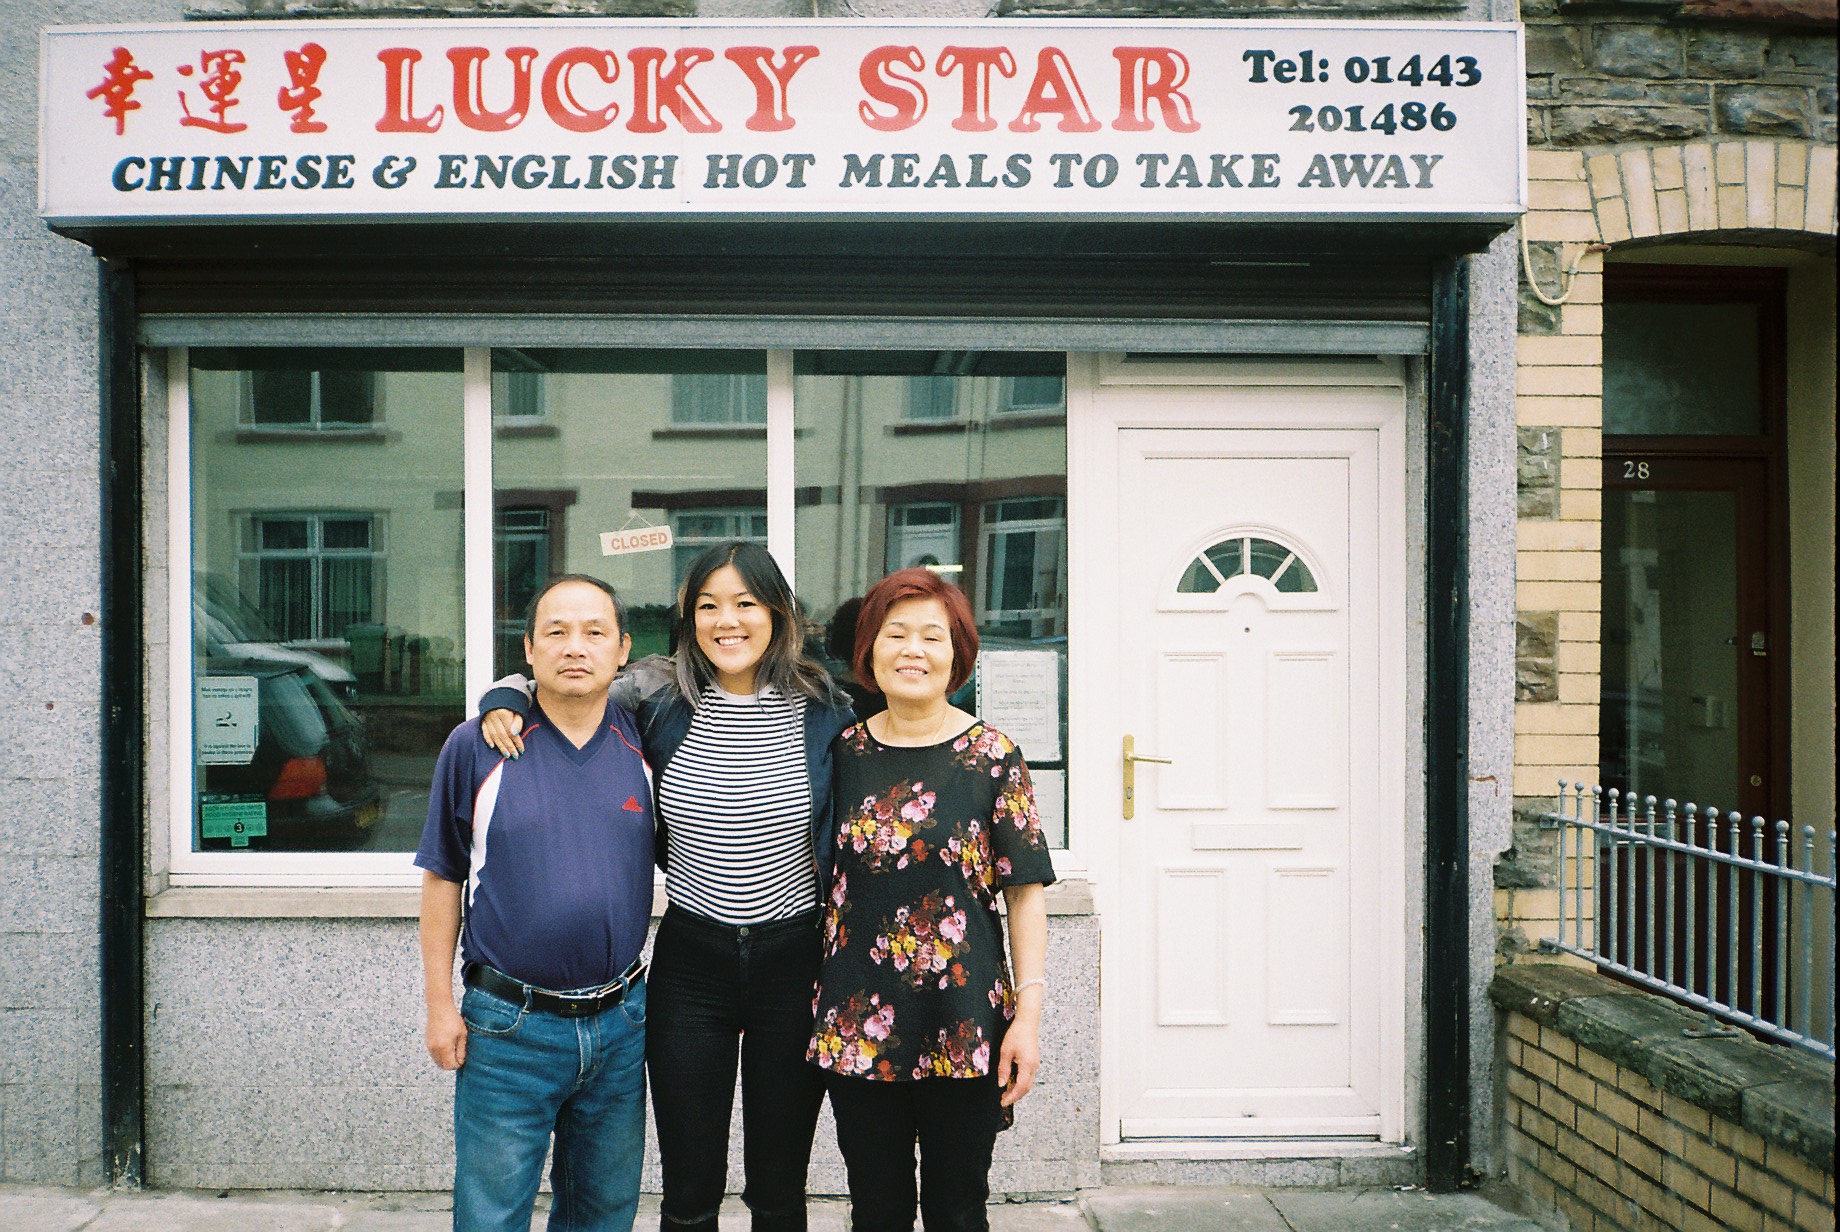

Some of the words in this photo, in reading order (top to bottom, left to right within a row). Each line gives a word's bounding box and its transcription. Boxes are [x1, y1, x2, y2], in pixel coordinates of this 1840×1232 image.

[1242, 50, 1329, 83] Tel:
[1344, 54, 1481, 87] 01443
[86, 42, 328, 136] 幸運星
[375, 46, 820, 134] LUCKY
[858, 45, 1200, 133] STAR
[1289, 102, 1457, 135] 201486
[112, 155, 355, 192] CHINESE
[373, 155, 416, 189] &
[434, 155, 678, 189] ENGLISH
[703, 154, 815, 188] HOT
[839, 154, 1031, 188] MEALS
[1050, 154, 1118, 188] TO
[1136, 154, 1280, 188] TAKE
[1298, 154, 1443, 188] AWAY
[1623, 460, 1650, 479] 28
[611, 532, 668, 550] CLOSED
[236, 823, 243, 832] 3
